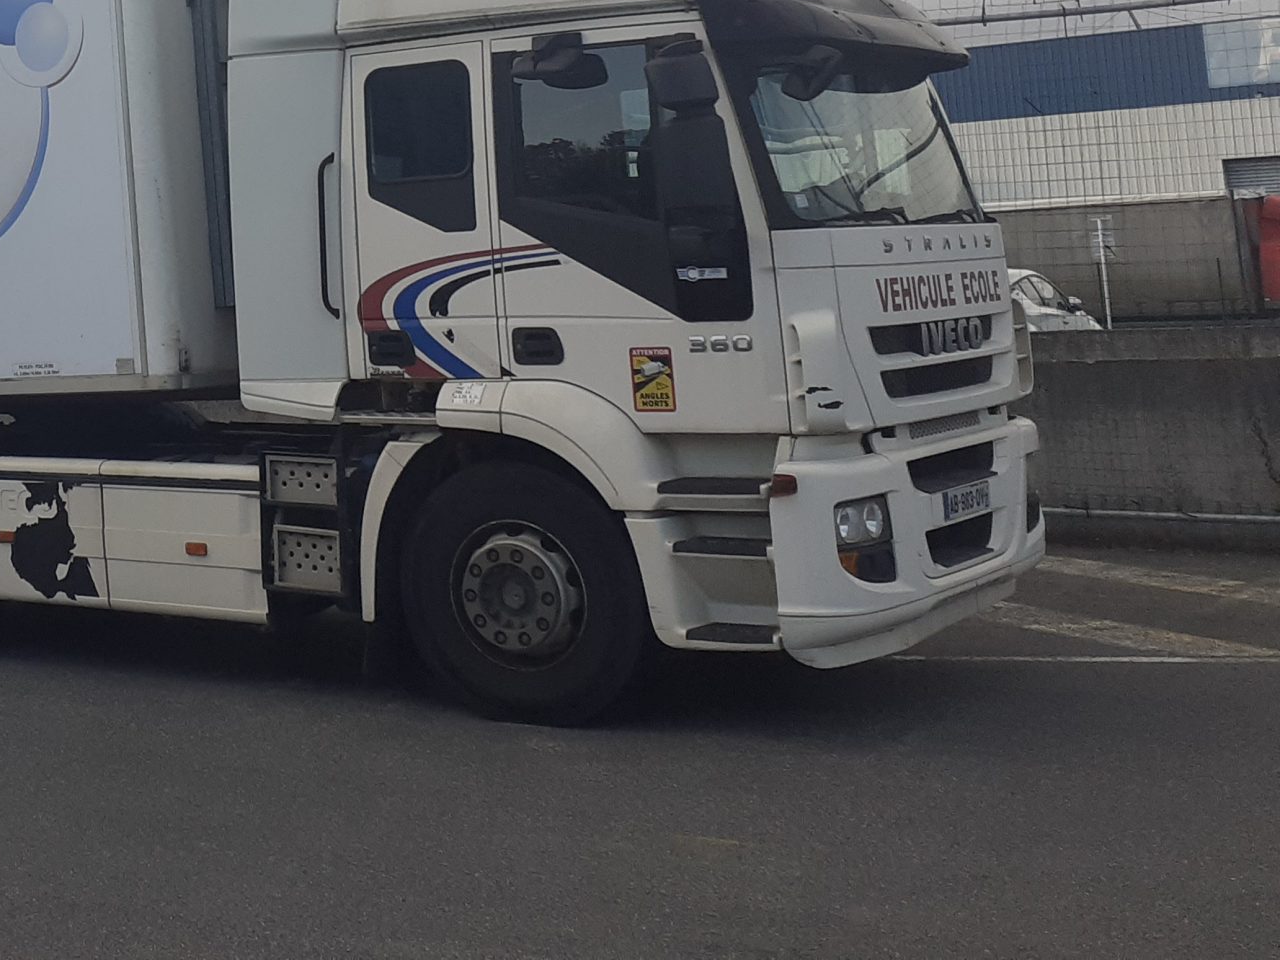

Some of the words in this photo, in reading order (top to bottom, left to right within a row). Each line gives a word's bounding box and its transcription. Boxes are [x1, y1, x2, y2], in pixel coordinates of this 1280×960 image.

[882, 233, 992, 254] STRALIS
[875, 273, 956, 313] VEHICULE
[960, 270, 1001, 305] ECOLE
[688, 334, 753, 353] 360
[920, 317, 983, 357] IVECO
[639, 392, 670, 400] ANGLES
